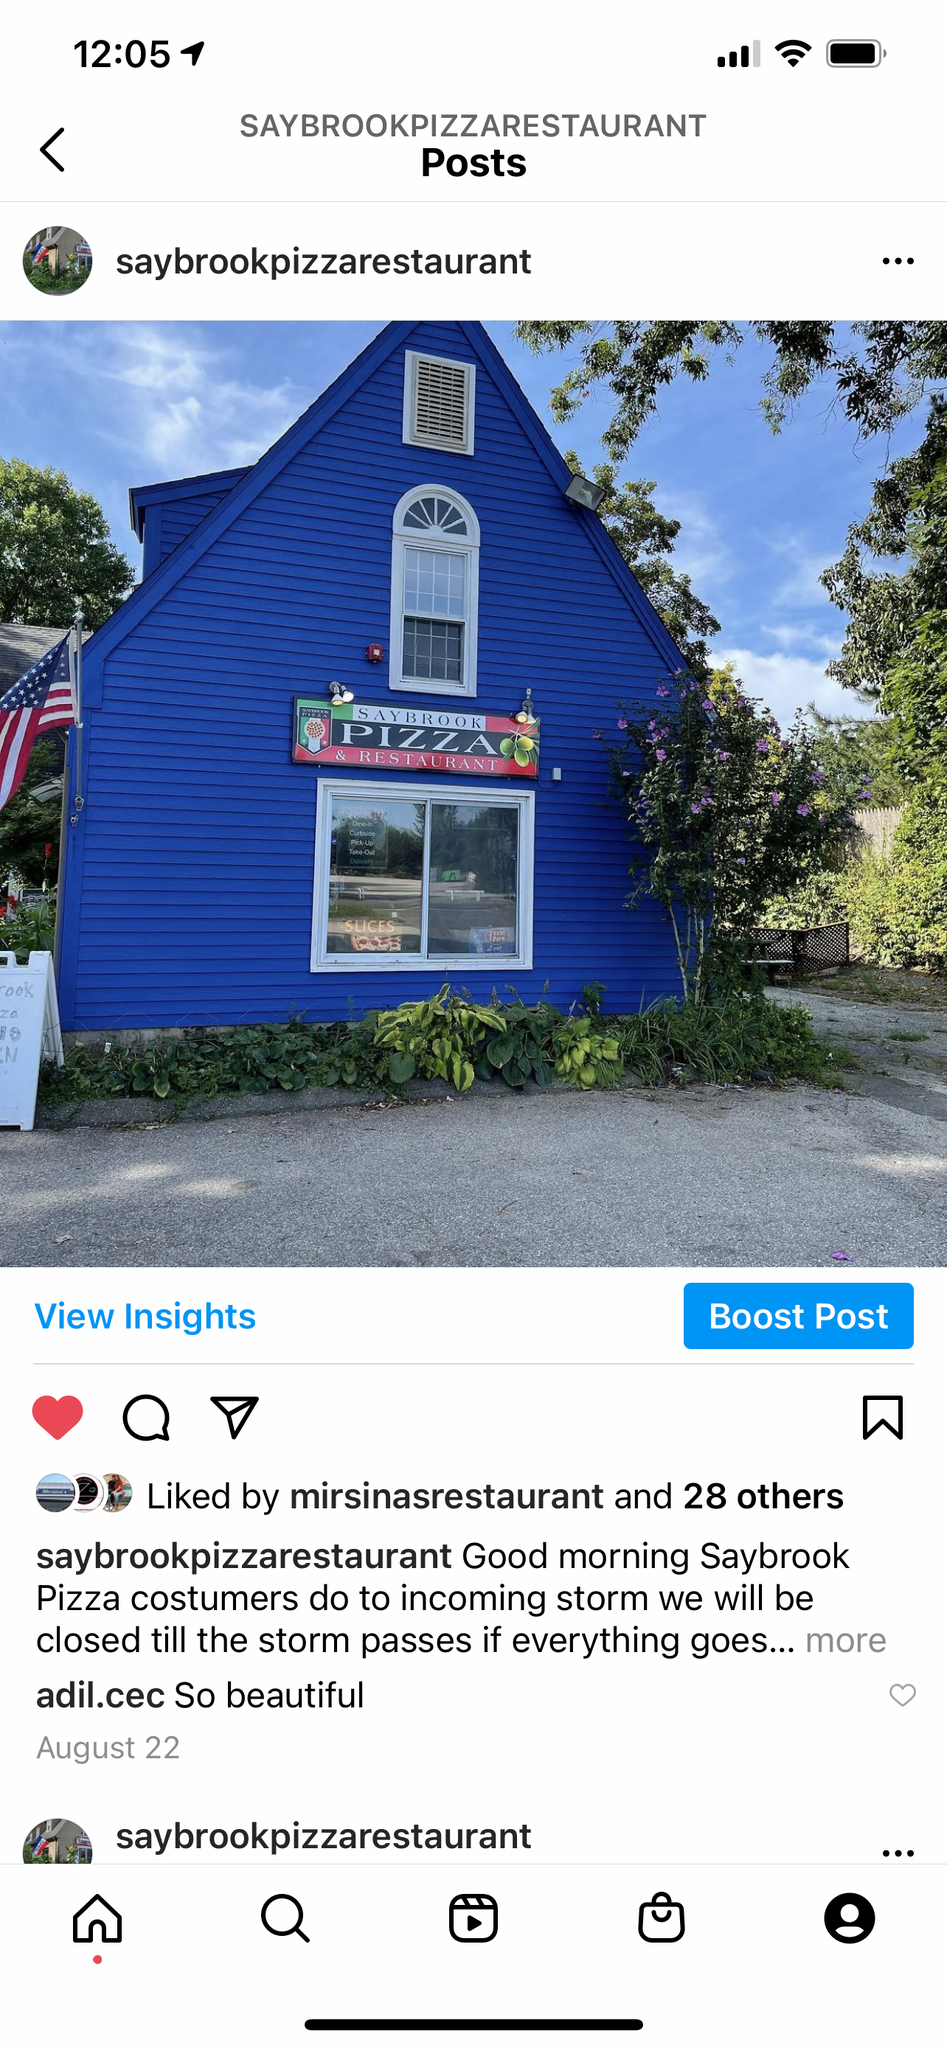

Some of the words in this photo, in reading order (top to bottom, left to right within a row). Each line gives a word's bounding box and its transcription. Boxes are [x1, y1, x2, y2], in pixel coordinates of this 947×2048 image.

[74, 40, 170, 68] 12:05
[240, 113, 707, 138] SAYBROOKPIZZARESTAURANT
[422, 147, 527, 178] Posts
[116, 245, 532, 281] saybrookpizzarestaurant
[358, 708, 482, 729] SAYBROOK
[340, 723, 499, 755] PIZZA
[335, 750, 347, 761] &
[359, 751, 498, 771] RESTAURANT
[350, 839, 374, 847] Pick-Up
[345, 919, 395, 933] SLICES
[34, 1301, 114, 1329] View
[126, 1301, 256, 1335] Insights
[710, 1303, 804, 1330] Boost
[816, 1303, 889, 1330] Post
[149, 1482, 229, 1509] Liked
[243, 1482, 279, 1515] by
[291, 1481, 603, 1509] mirsinasrestaurant
[615, 1482, 671, 1509] and
[684, 1482, 726, 1509] 28
[737, 1482, 843, 1509] others
[37, 1541, 452, 1575] saybrookpizzarestaurant
[463, 1542, 547, 1569] Good
[560, 1541, 688, 1575] morning
[701, 1542, 850, 1575] Saybrook
[38, 1583, 119, 1611] Pizza
[131, 1586, 298, 1611] costumers
[310, 1584, 348, 1611] do
[359, 1586, 390, 1611] to
[402, 1583, 545, 1617] incoming
[557, 1586, 647, 1611] storm
[659, 1591, 702, 1611] we
[714, 1583, 762, 1610] will
[776, 1584, 813, 1611] be
[37, 1626, 139, 1653] closed
[151, 1625, 185, 1653] till
[197, 1626, 247, 1653] the
[259, 1628, 349, 1653] storm
[362, 1633, 471, 1659] passes
[484, 1625, 502, 1652] if
[513, 1625, 679, 1659] everything
[807, 1633, 886, 1653] more
[37, 1680, 165, 1708] adil.cec
[175, 1681, 215, 1708] So
[228, 1681, 363, 1708] beautiful
[37, 1736, 135, 1764] August
[146, 1736, 179, 1758] 22
[116, 1820, 532, 1856] saybrookpizzarestaurant
